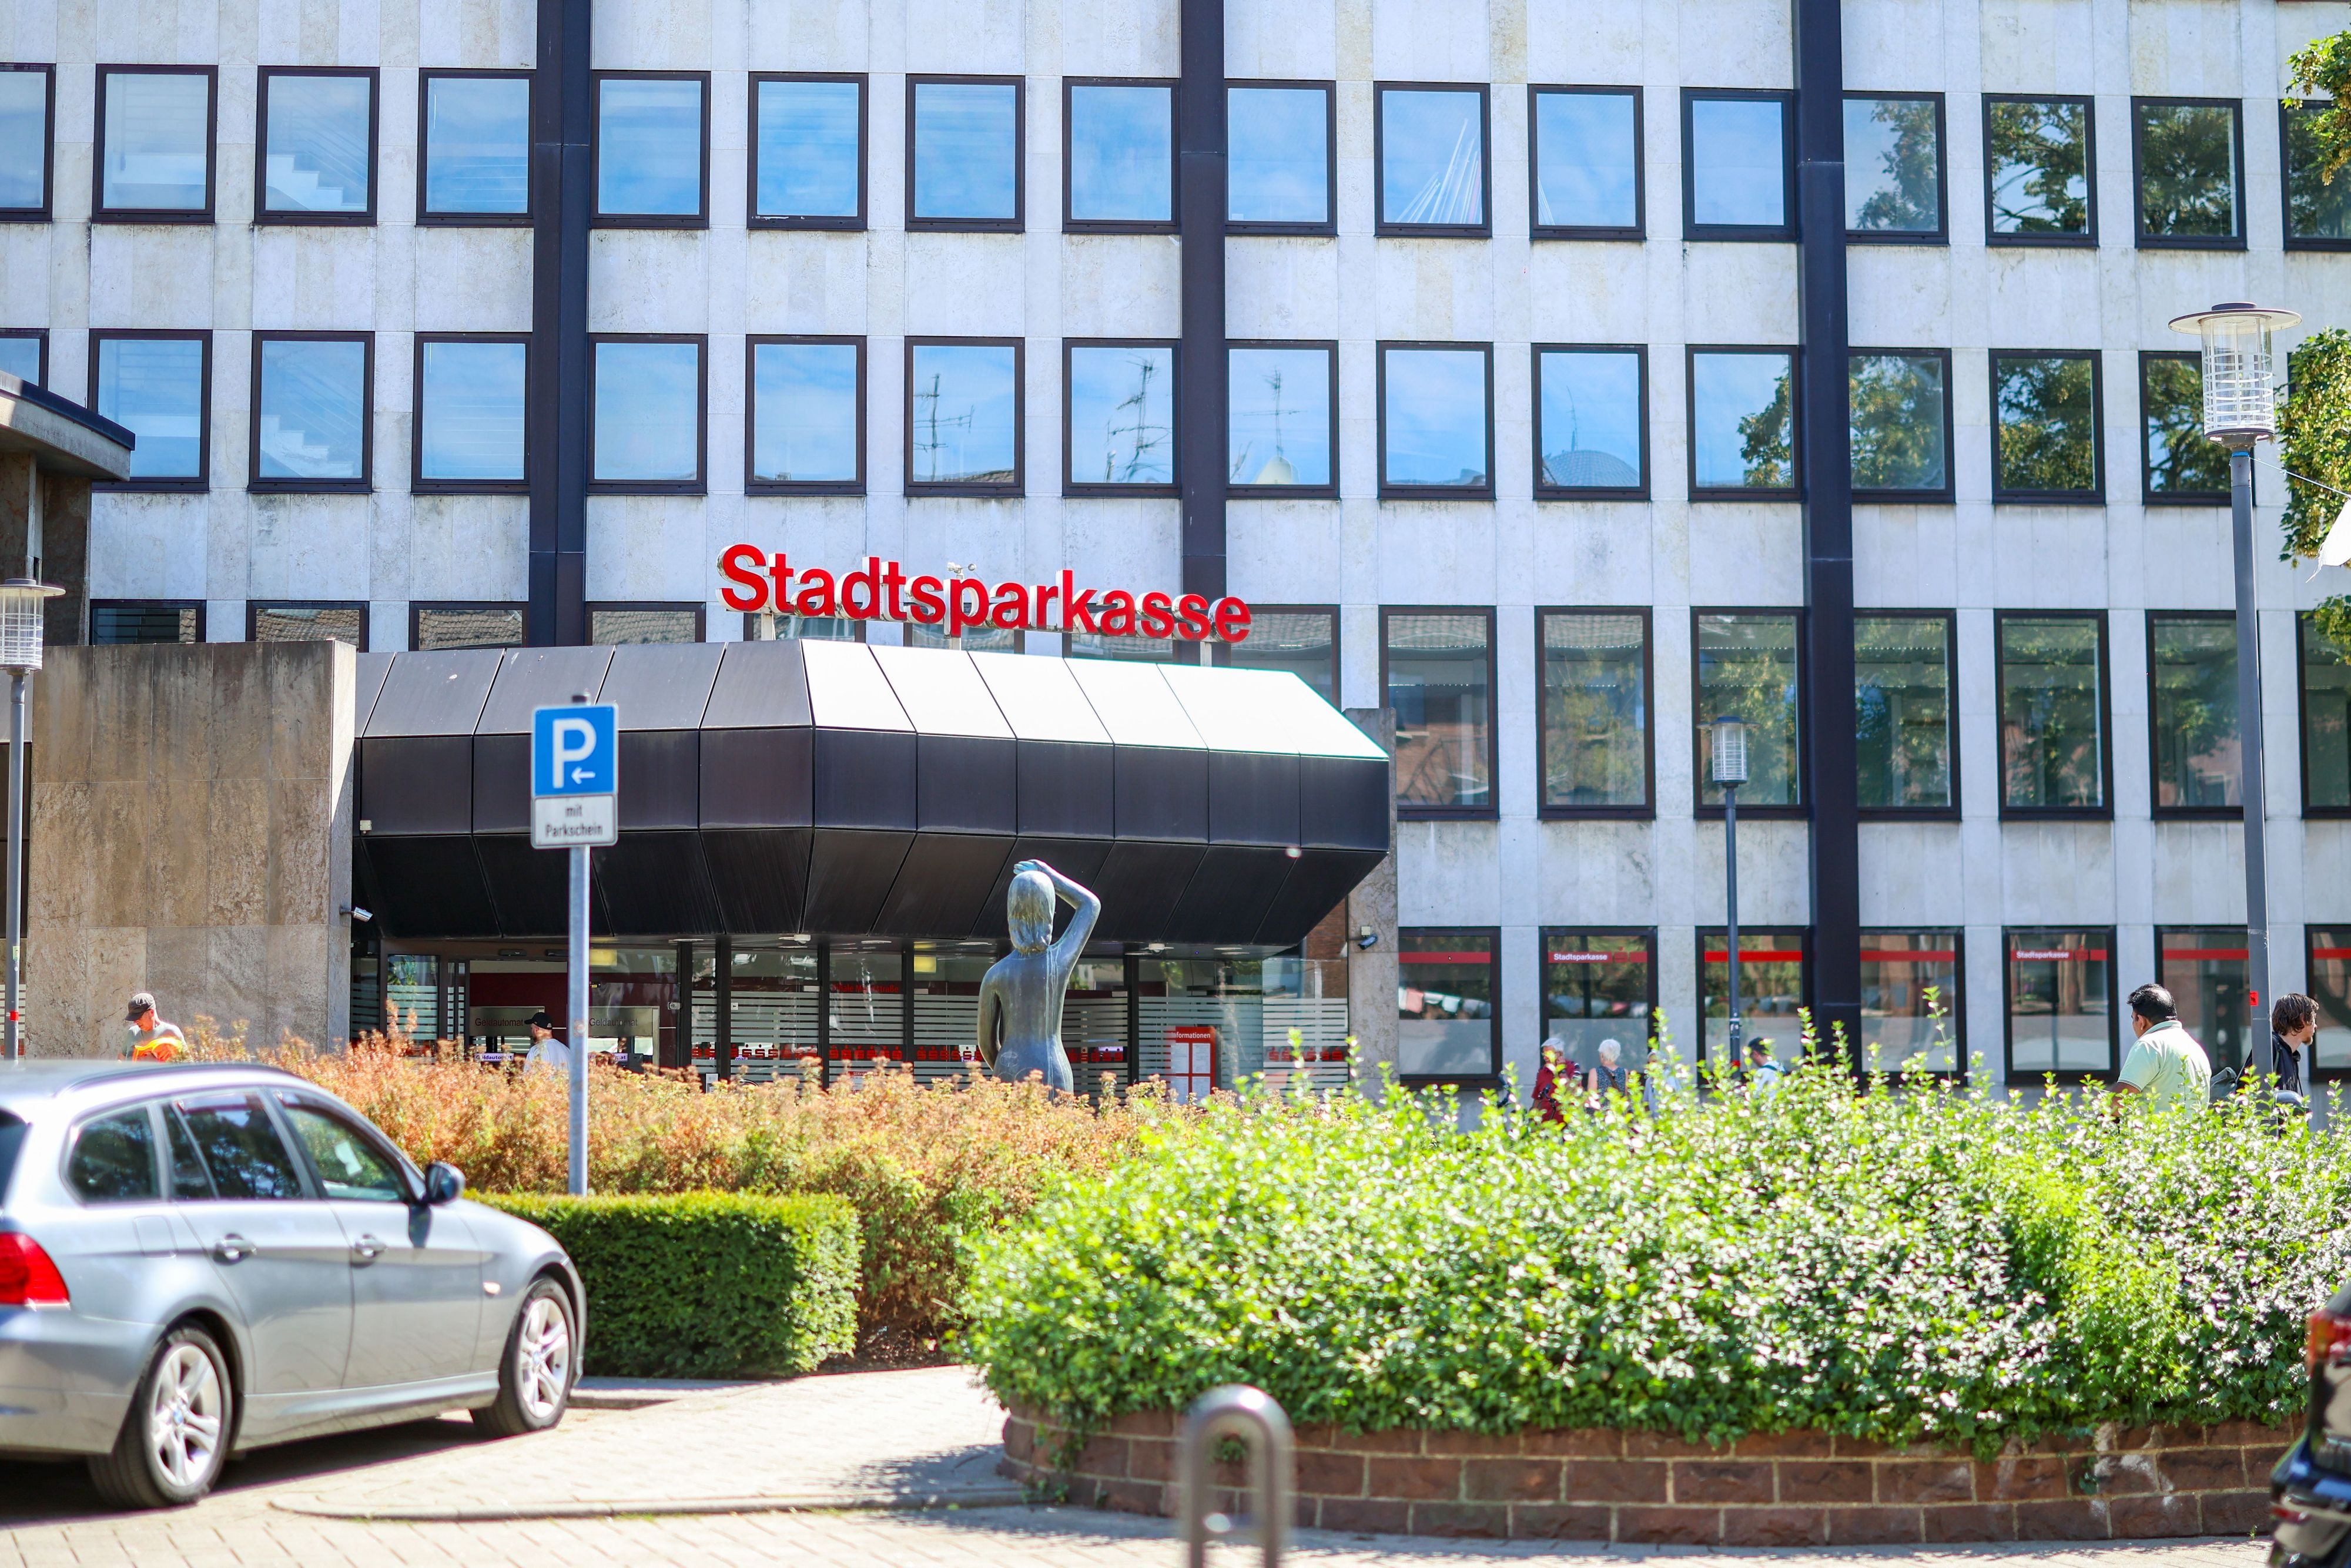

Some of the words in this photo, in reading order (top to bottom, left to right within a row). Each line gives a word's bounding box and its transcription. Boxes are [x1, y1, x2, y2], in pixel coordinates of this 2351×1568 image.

[718, 543, 1252, 643] Stadtsparkasse
[552, 718, 597, 789] P
[565, 805, 582, 817] mit
[545, 823, 603, 837] Parkschein
[1553, 953, 1608, 961] Stadtsparkasse
[2016, 951, 2069, 959] Stadtsparkasse
[475, 1018, 524, 1026] Geldautomat
